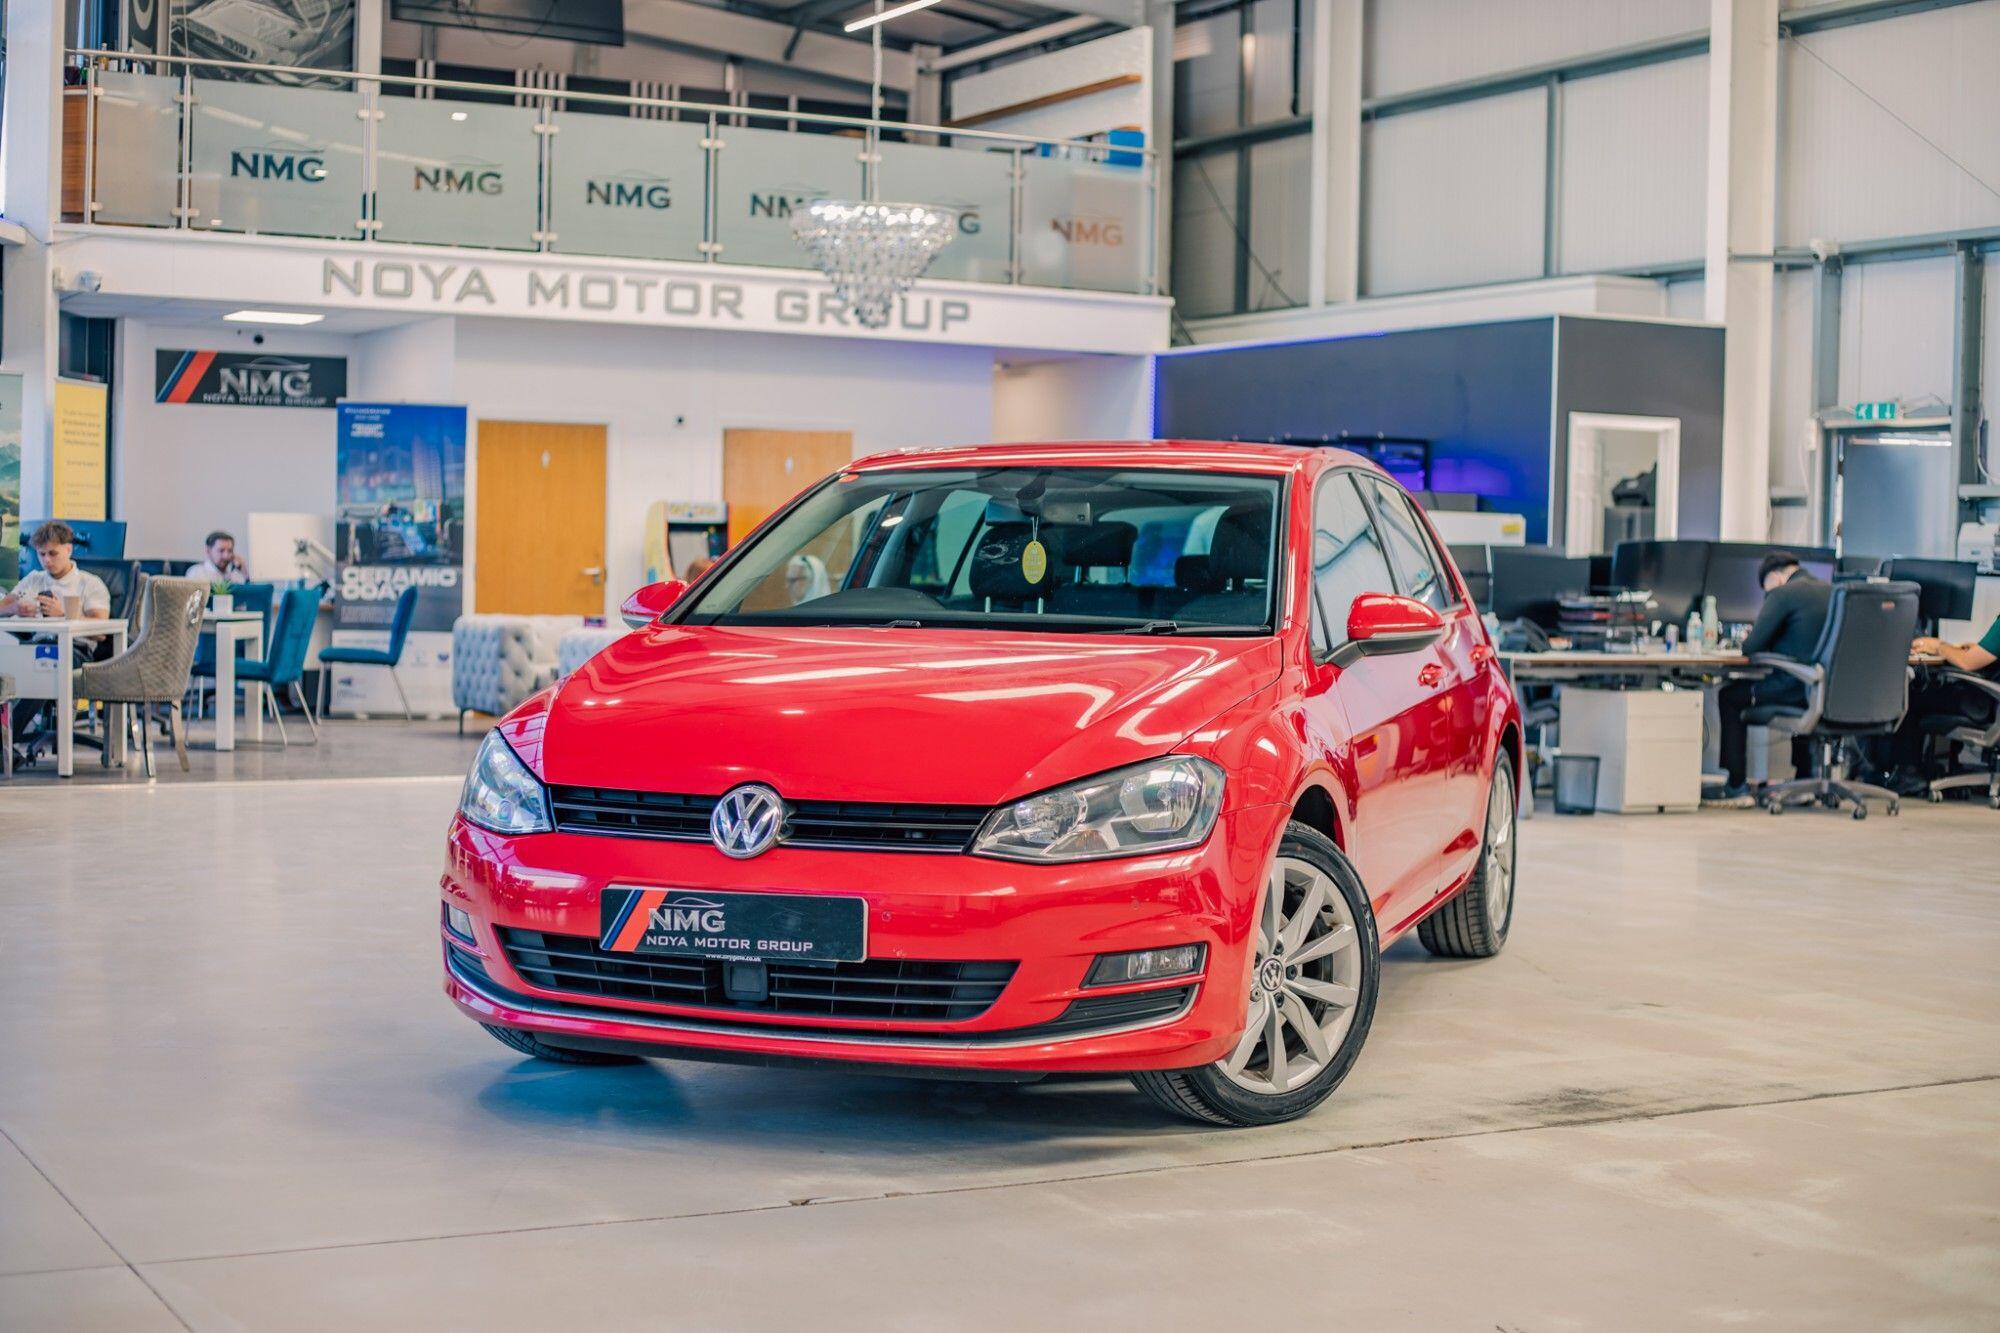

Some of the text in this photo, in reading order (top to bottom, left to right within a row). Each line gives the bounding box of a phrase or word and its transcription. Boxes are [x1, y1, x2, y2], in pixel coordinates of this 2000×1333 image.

[231, 151, 326, 182] NMG
[414, 166, 503, 195] NMG
[586, 180, 671, 209] NMG
[750, 192, 806, 218] NM
[1050, 219, 1123, 247] NMG
[322, 257, 496, 304] NOYA
[528, 270, 744, 319] MOTOR
[219, 367, 312, 397] NMG
[342, 566, 457, 588] CERAMIC
[341, 582, 404, 601] COA
[648, 908, 726, 933] NMG
[646, 935, 814, 952] NOYA MOTOR GROUP
